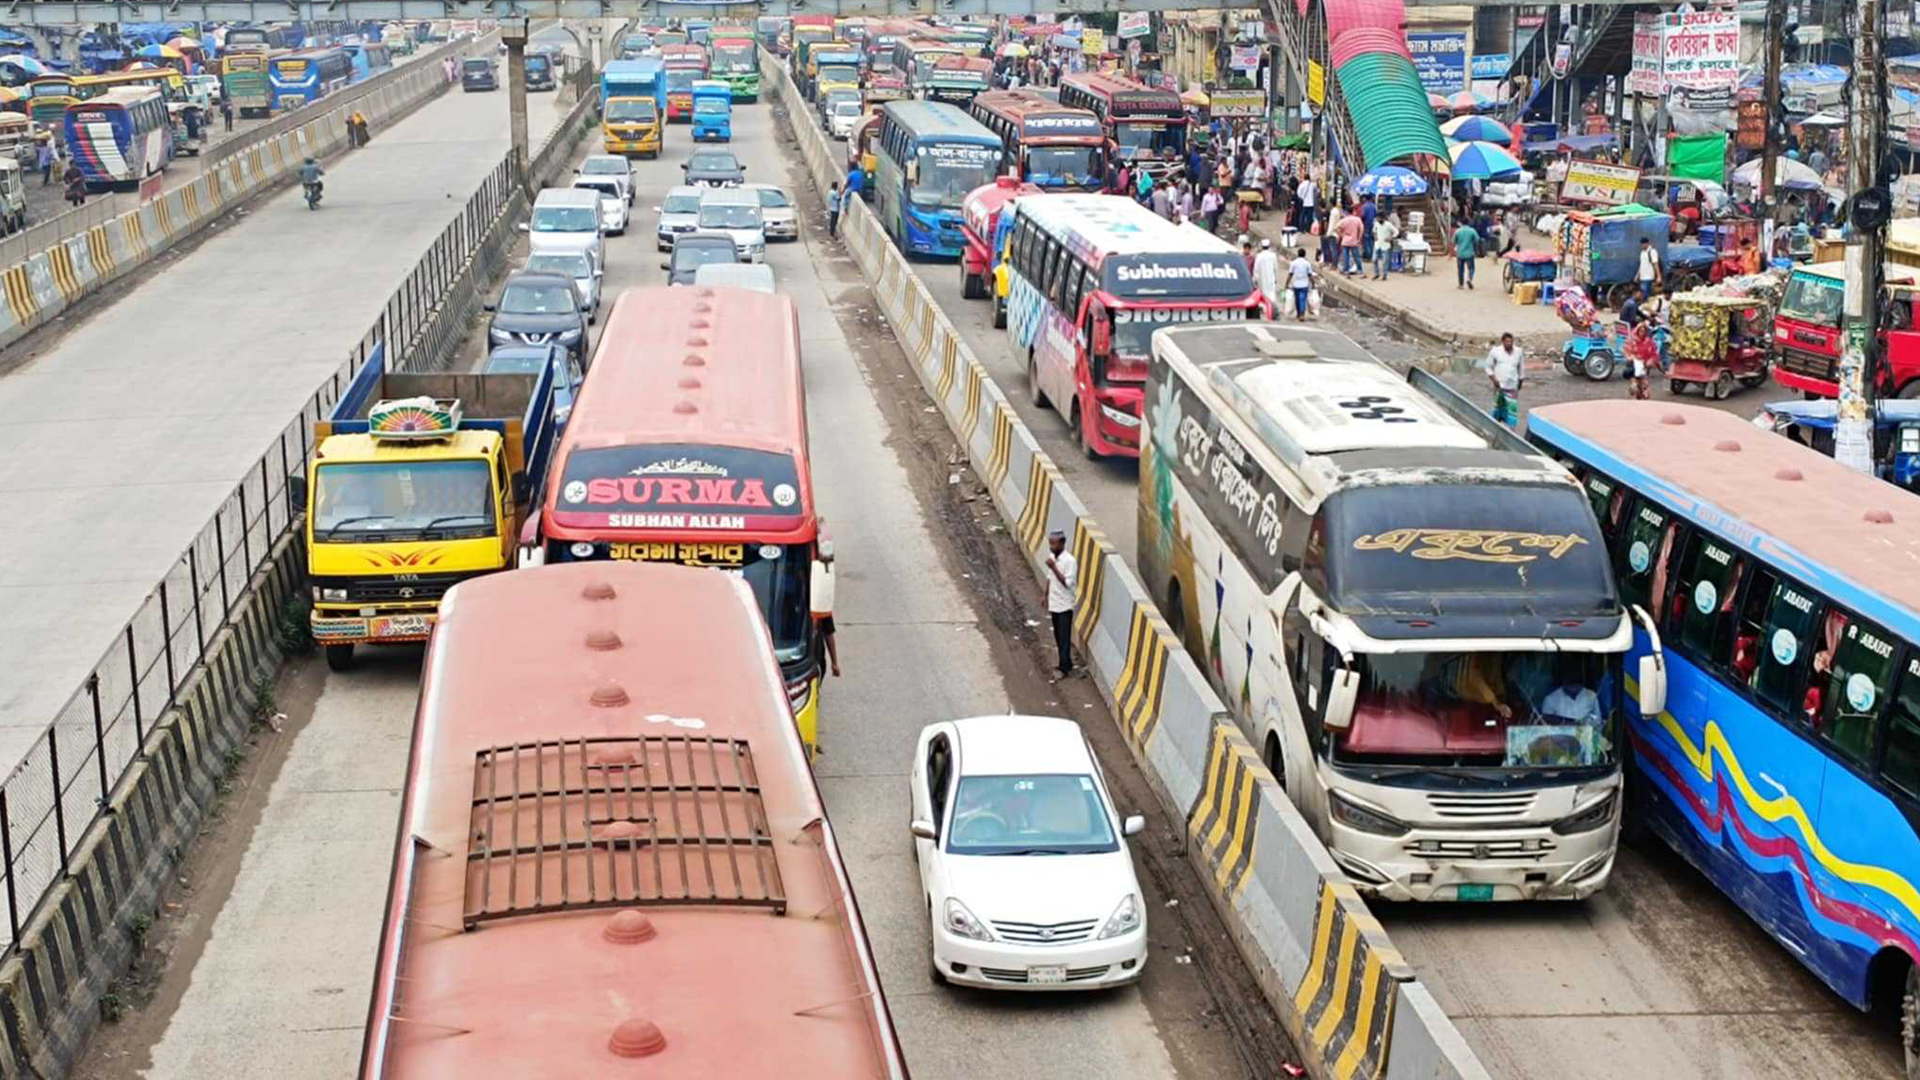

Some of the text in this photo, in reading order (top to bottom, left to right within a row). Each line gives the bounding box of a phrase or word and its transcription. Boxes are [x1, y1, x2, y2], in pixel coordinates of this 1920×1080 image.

[1665, 27, 1711, 57] কোরিয়ান
[1117, 262, 1239, 280] Subhanallah
[588, 477, 771, 507] SURMA
[608, 513, 745, 528] SUBHAN ALLAH
[1353, 528, 1589, 563] একুশে
[393, 573, 420, 582] TATA
